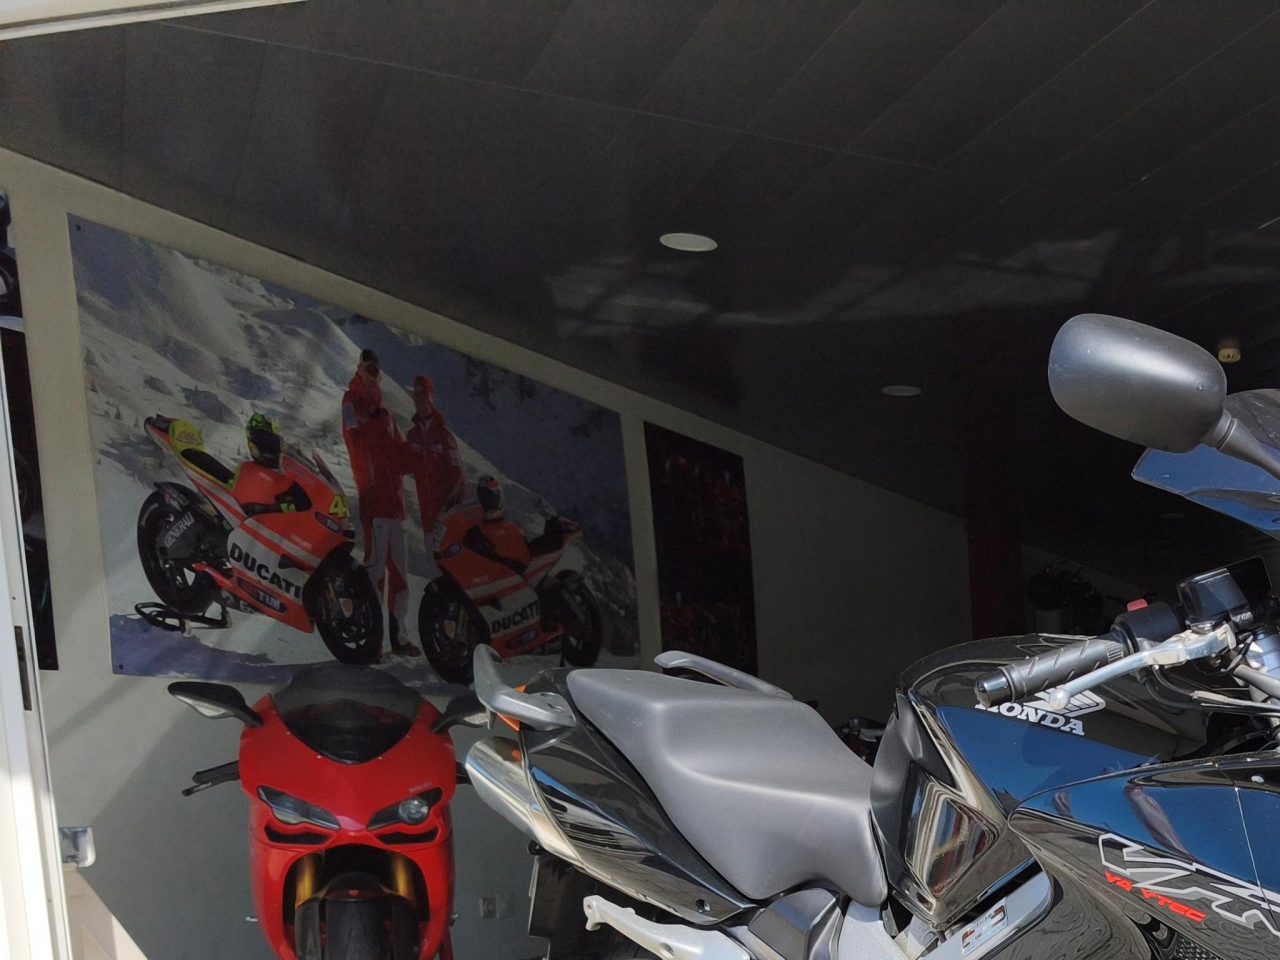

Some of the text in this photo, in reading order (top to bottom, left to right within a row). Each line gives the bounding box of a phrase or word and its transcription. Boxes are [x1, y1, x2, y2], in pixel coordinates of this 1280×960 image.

[229, 541, 302, 599] DUCATI
[491, 600, 541, 634] DUCATI
[1140, 887, 1207, 923] VTEC
